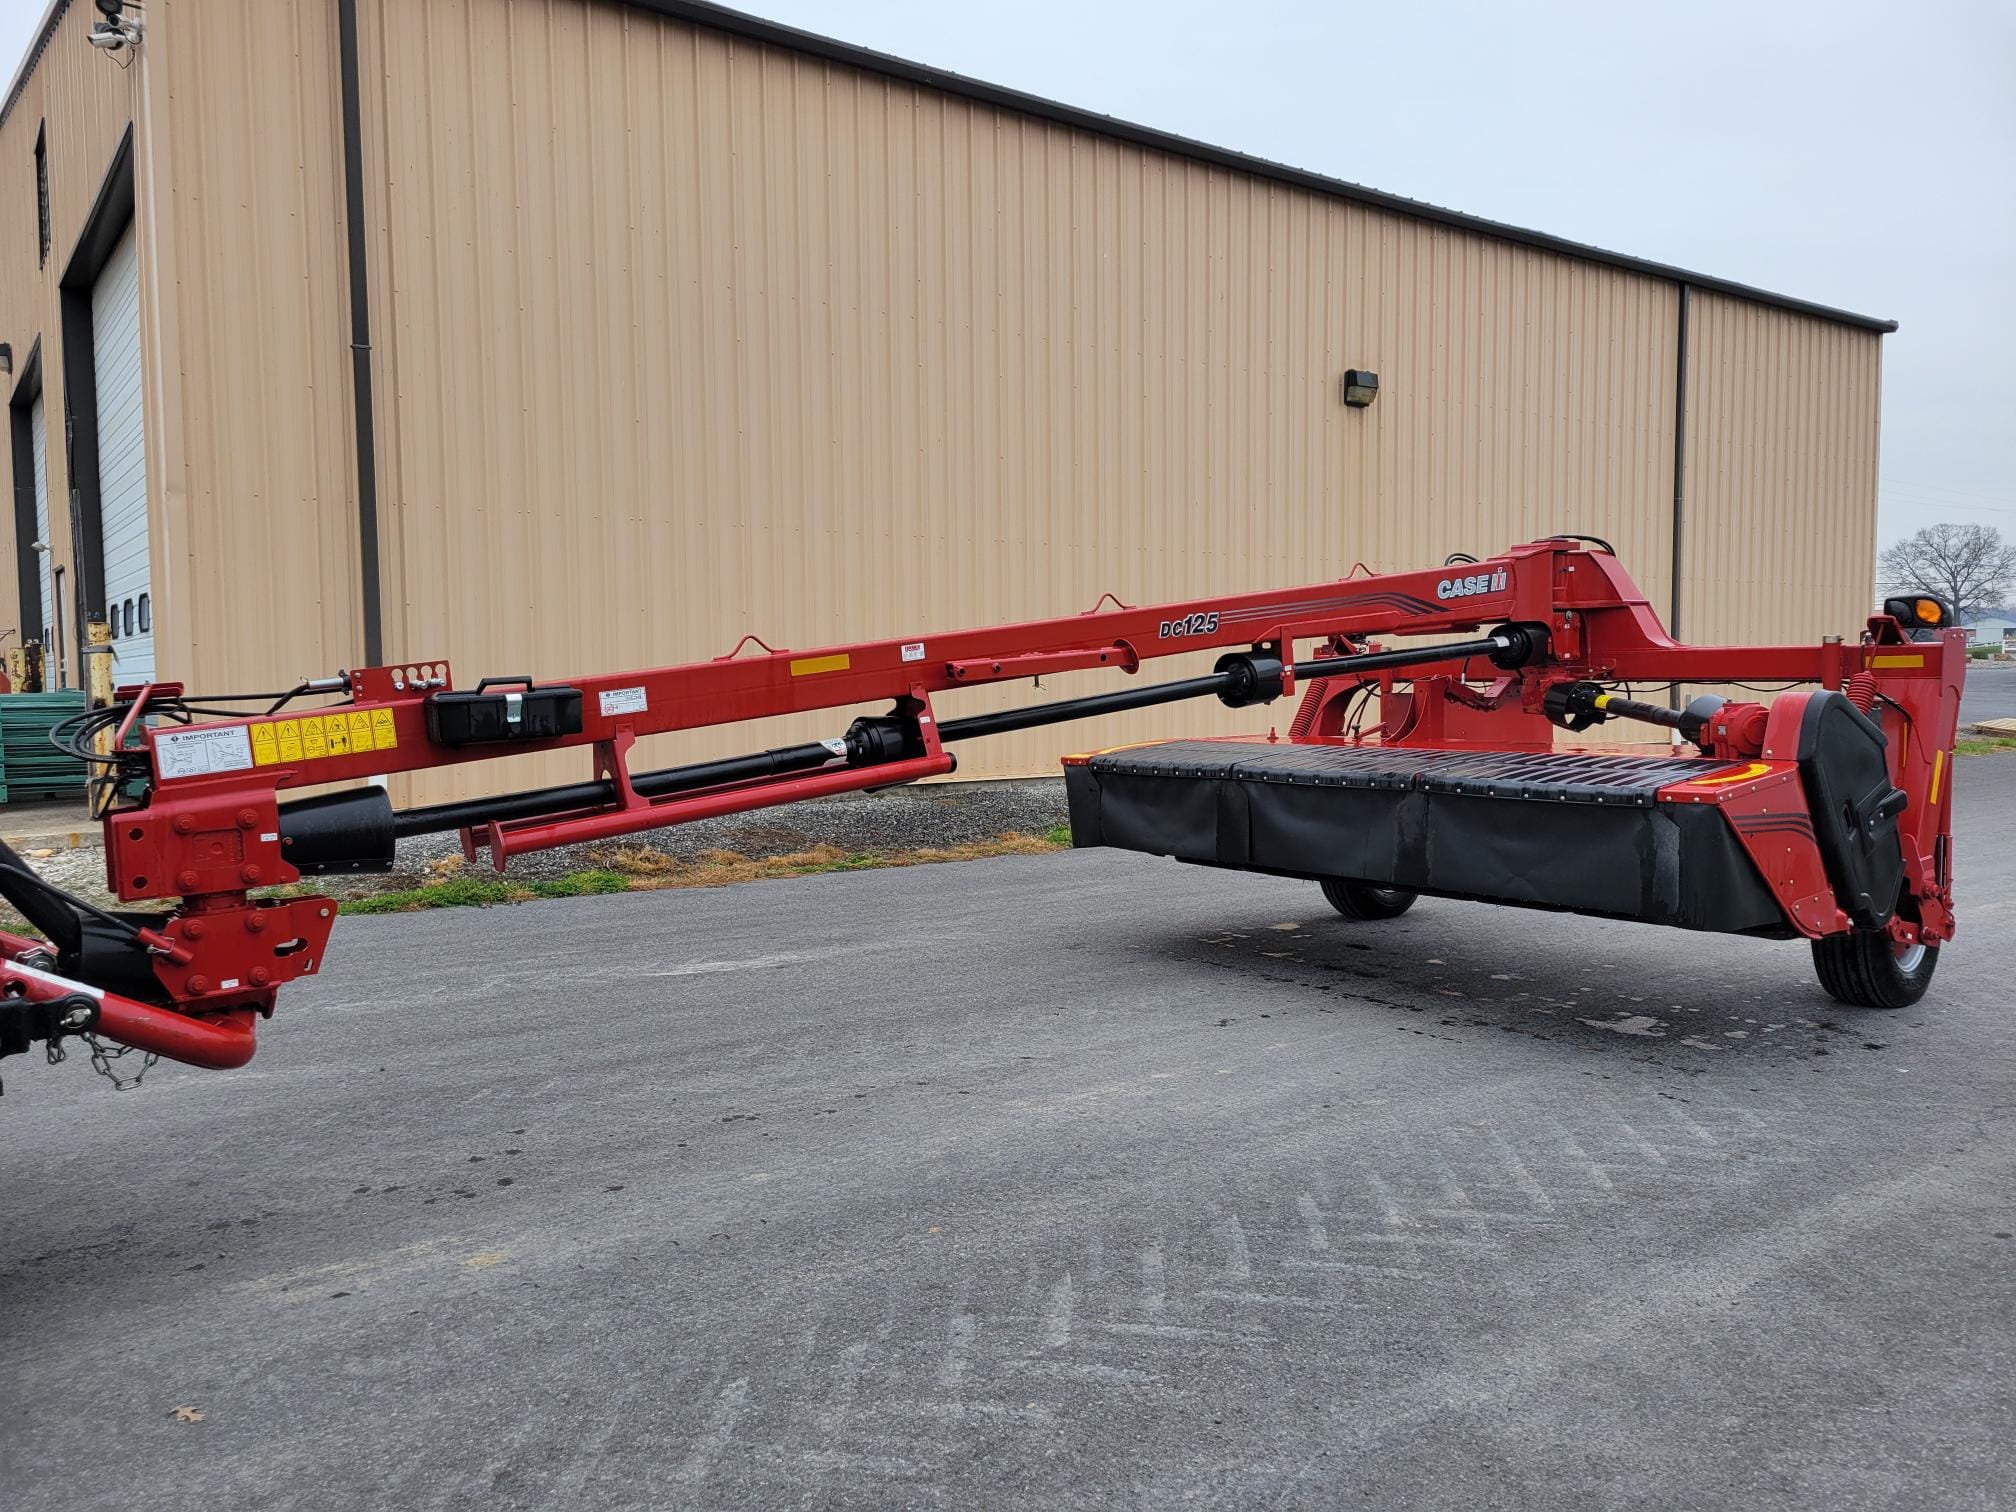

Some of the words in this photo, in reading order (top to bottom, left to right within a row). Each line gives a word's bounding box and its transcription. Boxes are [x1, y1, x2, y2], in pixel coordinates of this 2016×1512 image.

[1437, 574, 1490, 599] CASE
[1159, 611, 1220, 638] DC125
[612, 688, 642, 697] IMPORTANT
[182, 730, 236, 742] IMPORTANT
